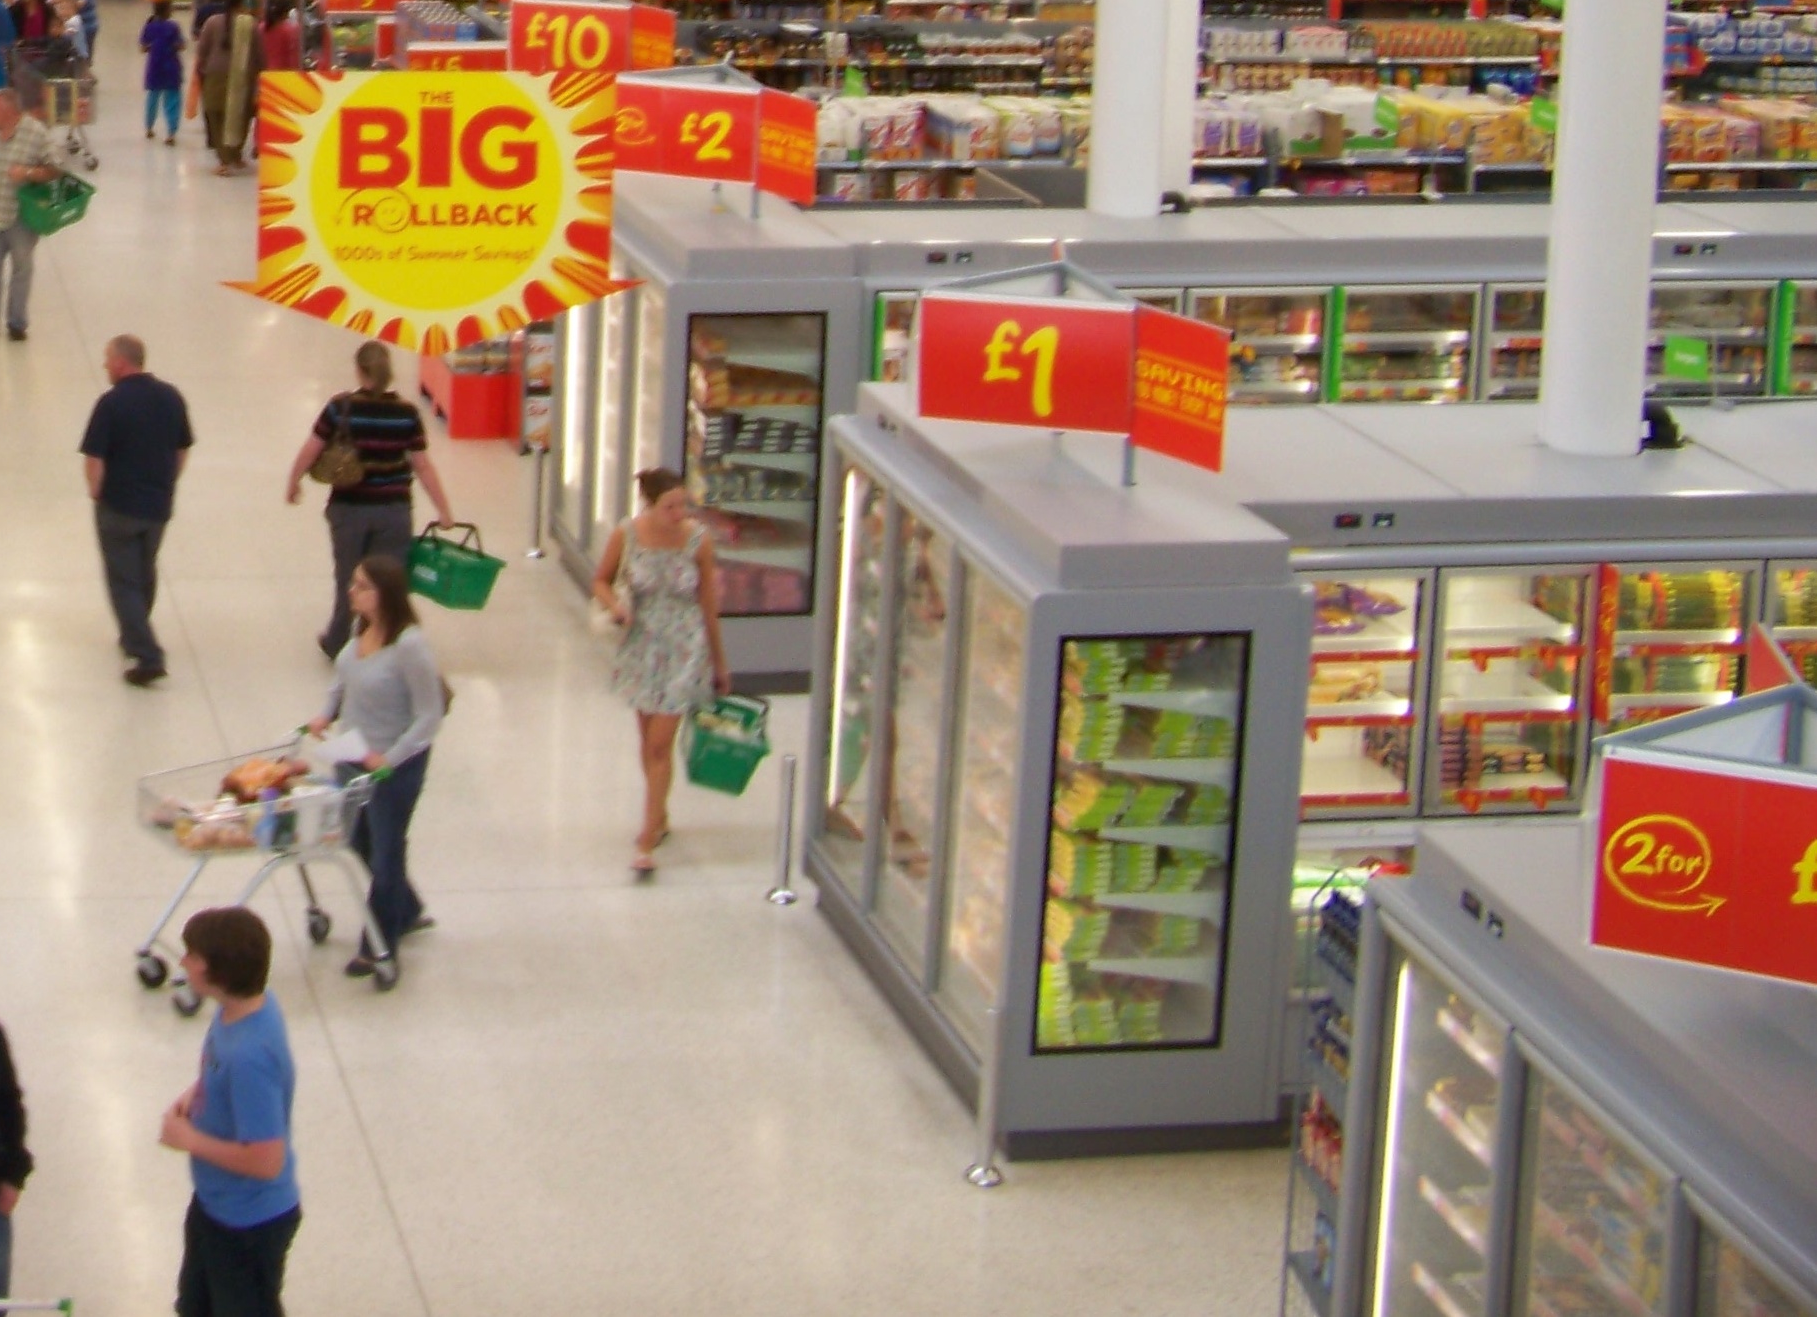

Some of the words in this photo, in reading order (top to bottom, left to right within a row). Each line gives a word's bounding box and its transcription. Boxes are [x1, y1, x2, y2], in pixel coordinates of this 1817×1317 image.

[525, 10, 611, 71] £10
[418, 90, 454, 104] THE
[337, 105, 539, 191] BIG
[679, 110, 733, 162] £2
[351, 197, 537, 232] ROLLBACK
[335, 245, 383, 262] 1000s
[386, 245, 404, 262] of
[407, 245, 469, 262] Summer
[983, 319, 1061, 418] £1
[1619, 831, 1704, 877] 2for
